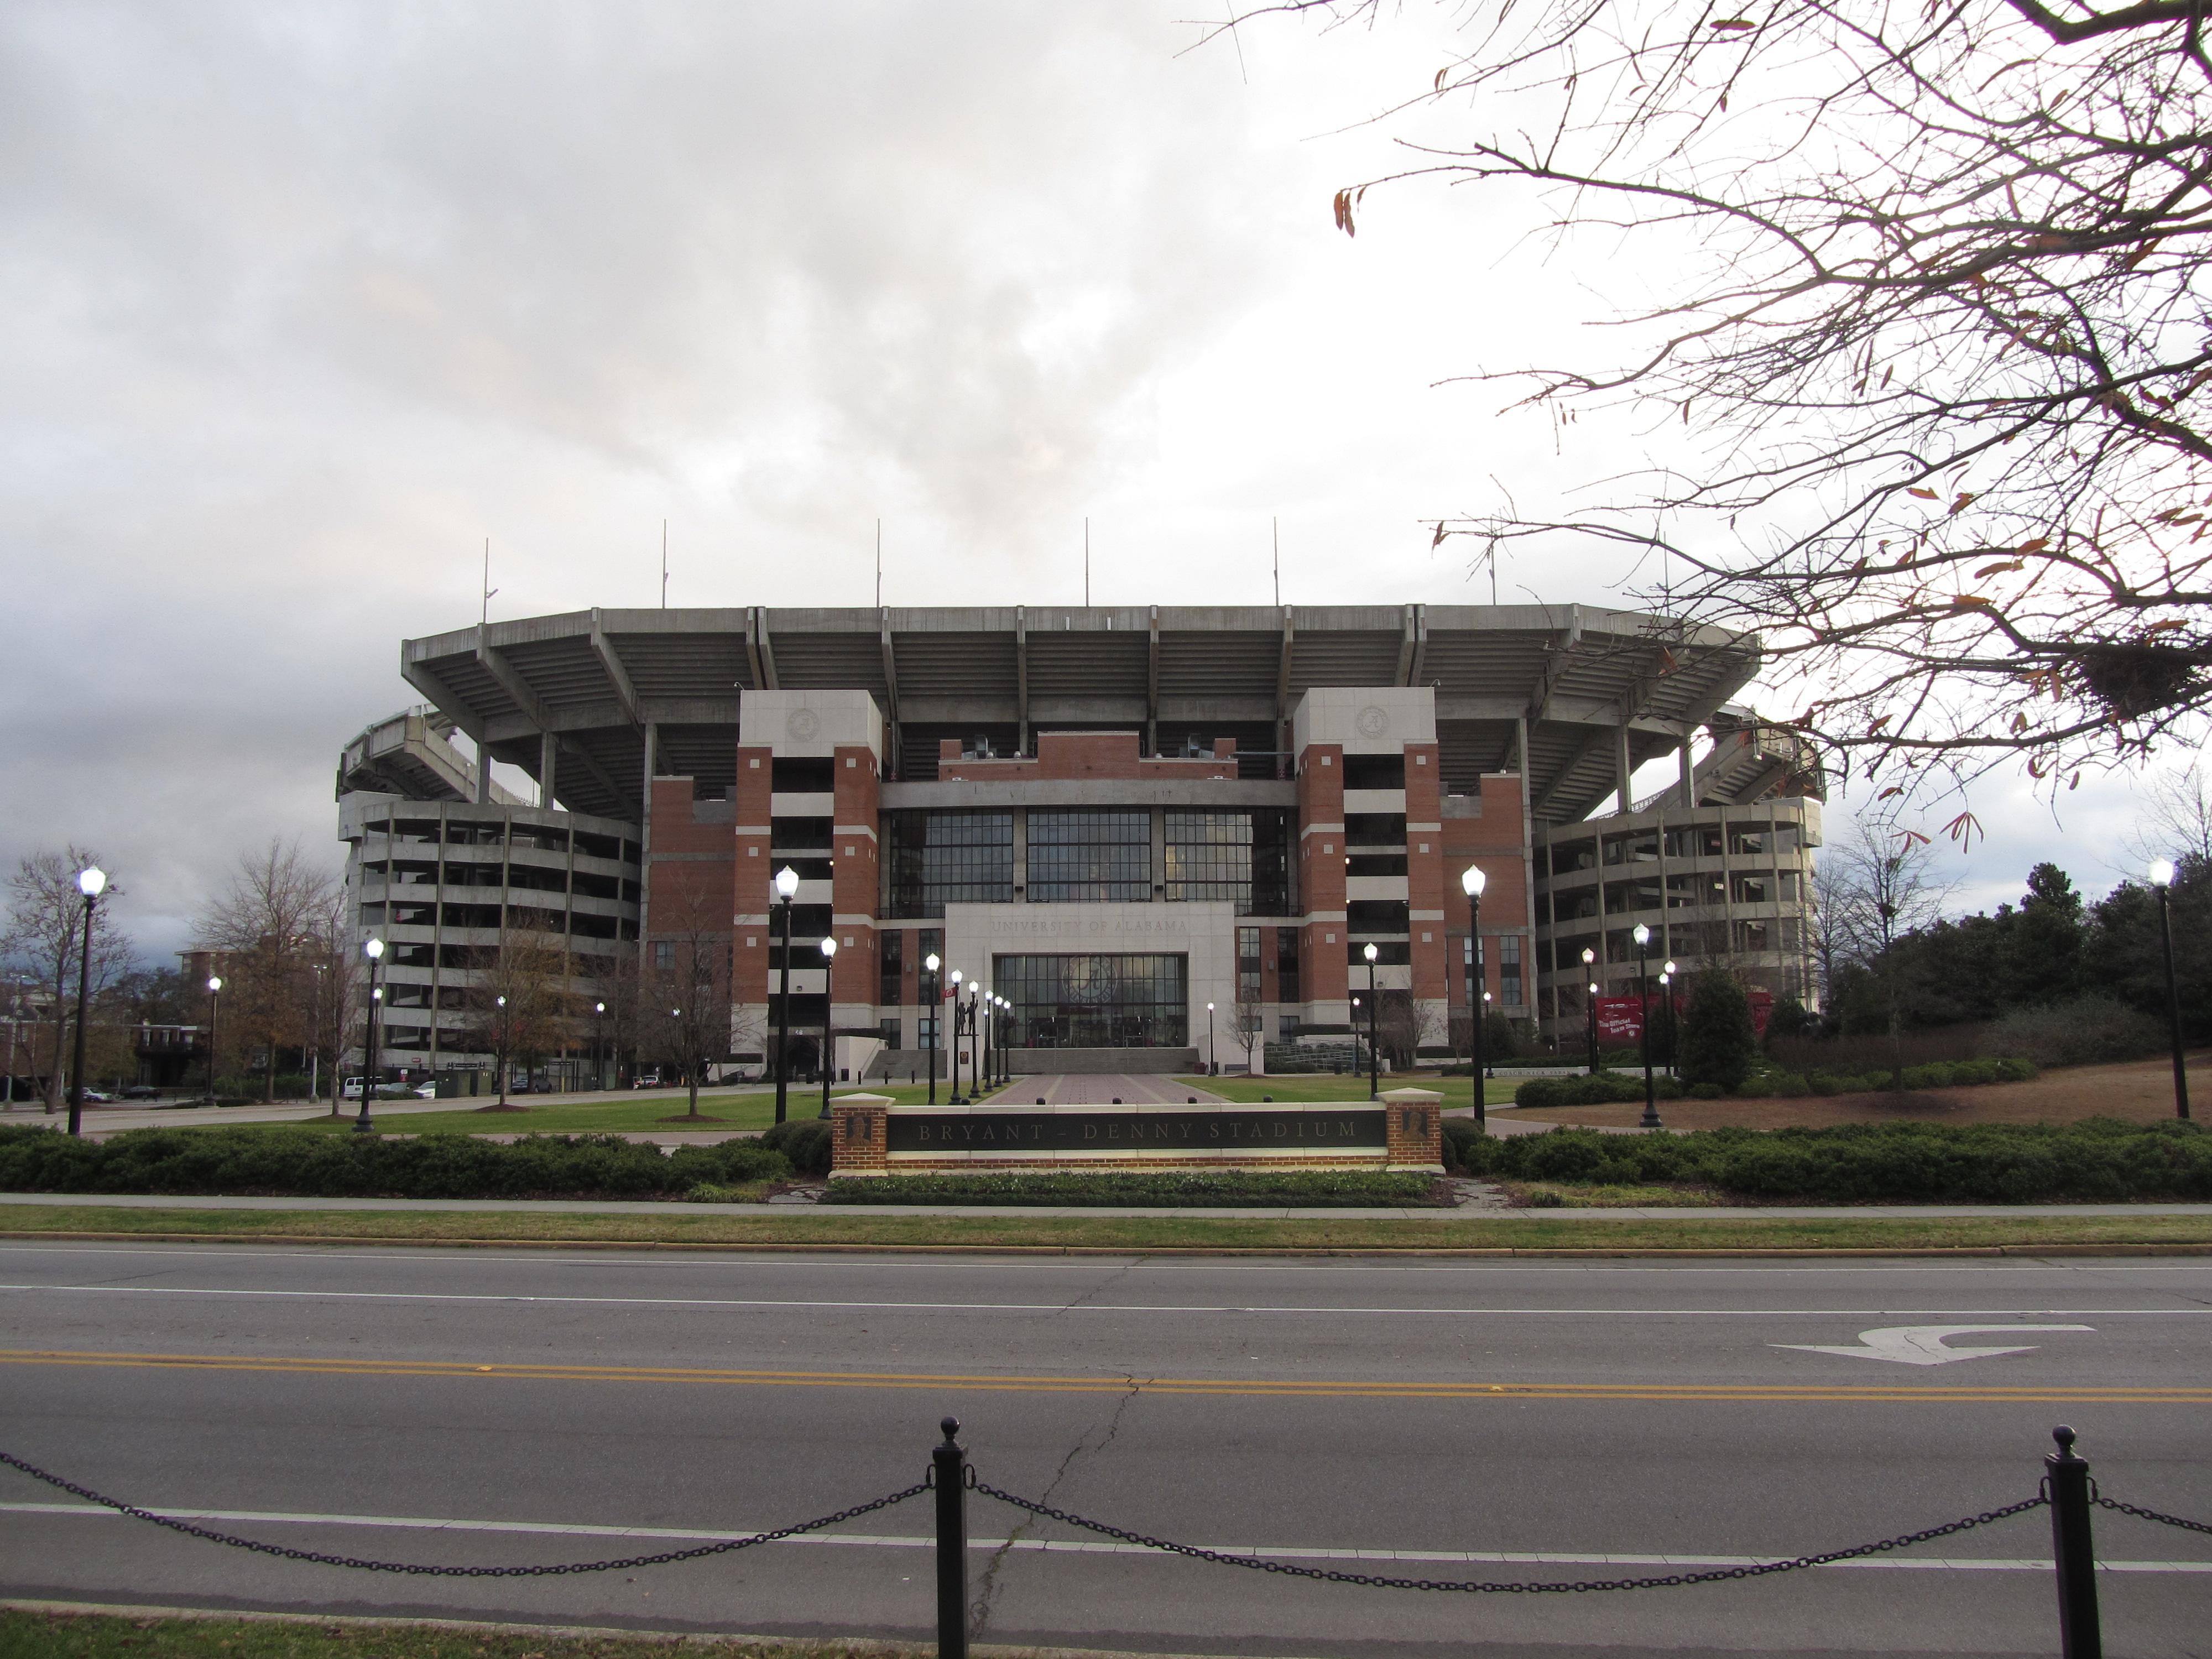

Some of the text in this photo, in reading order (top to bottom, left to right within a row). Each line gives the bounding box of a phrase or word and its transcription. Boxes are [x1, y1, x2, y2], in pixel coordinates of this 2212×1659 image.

[991, 920, 1187, 931] UNIVERSITY OF ALABAMA
[1610, 1018, 1630, 1026] Official
[919, 1124, 1042, 1140] BRYANT
[1084, 1123, 1192, 1139] DENNY
[1209, 1121, 1355, 1138] STADIUM
